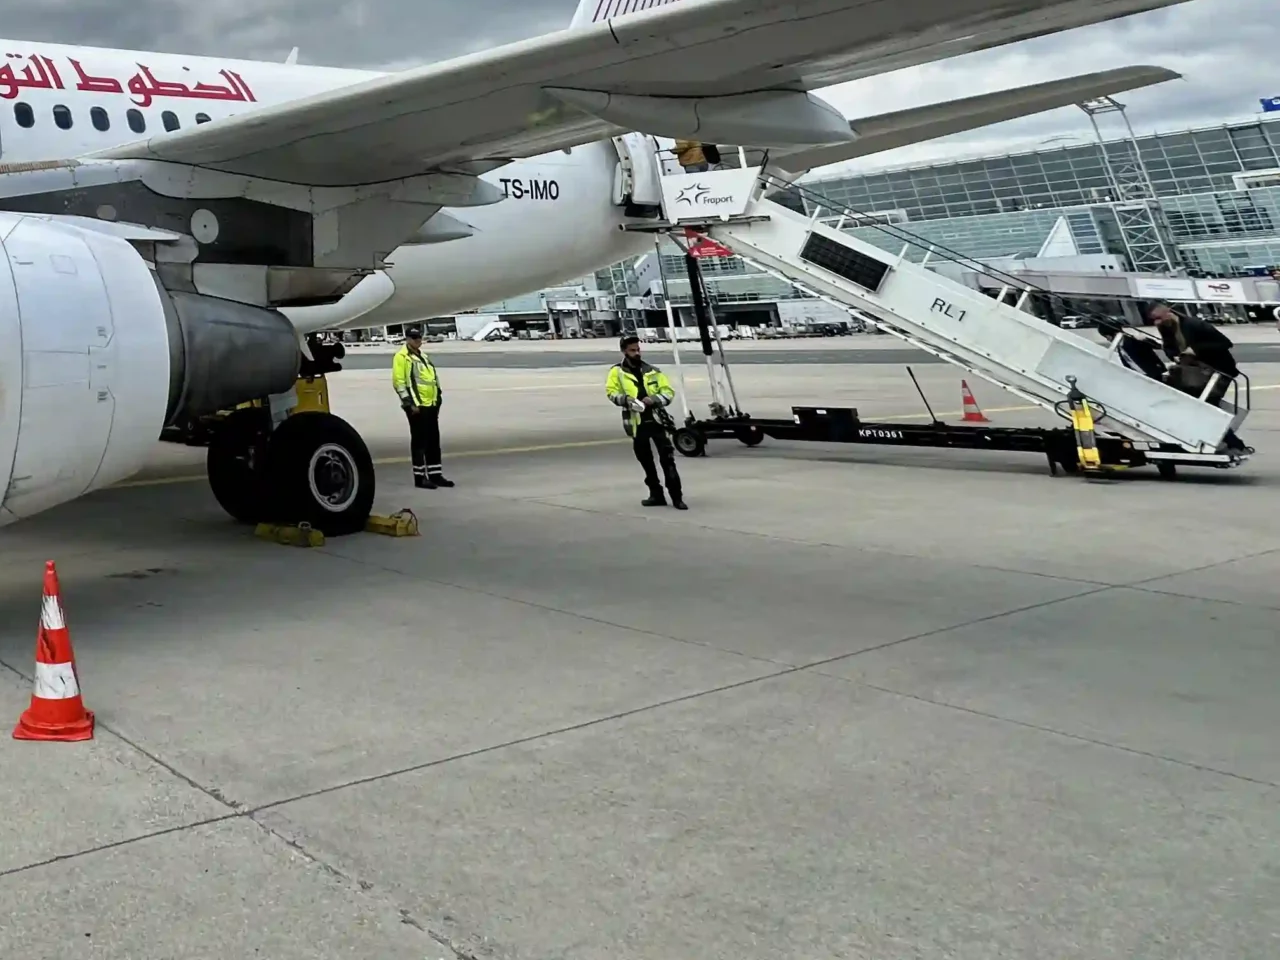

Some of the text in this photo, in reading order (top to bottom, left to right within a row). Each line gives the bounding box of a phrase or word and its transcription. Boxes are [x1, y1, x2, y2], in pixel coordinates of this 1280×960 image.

[66, 56, 258, 107] الخطوط
[499, 178, 559, 200] TS-IMO
[703, 195, 733, 205] Fraport
[858, 429, 904, 438] KPT0361
